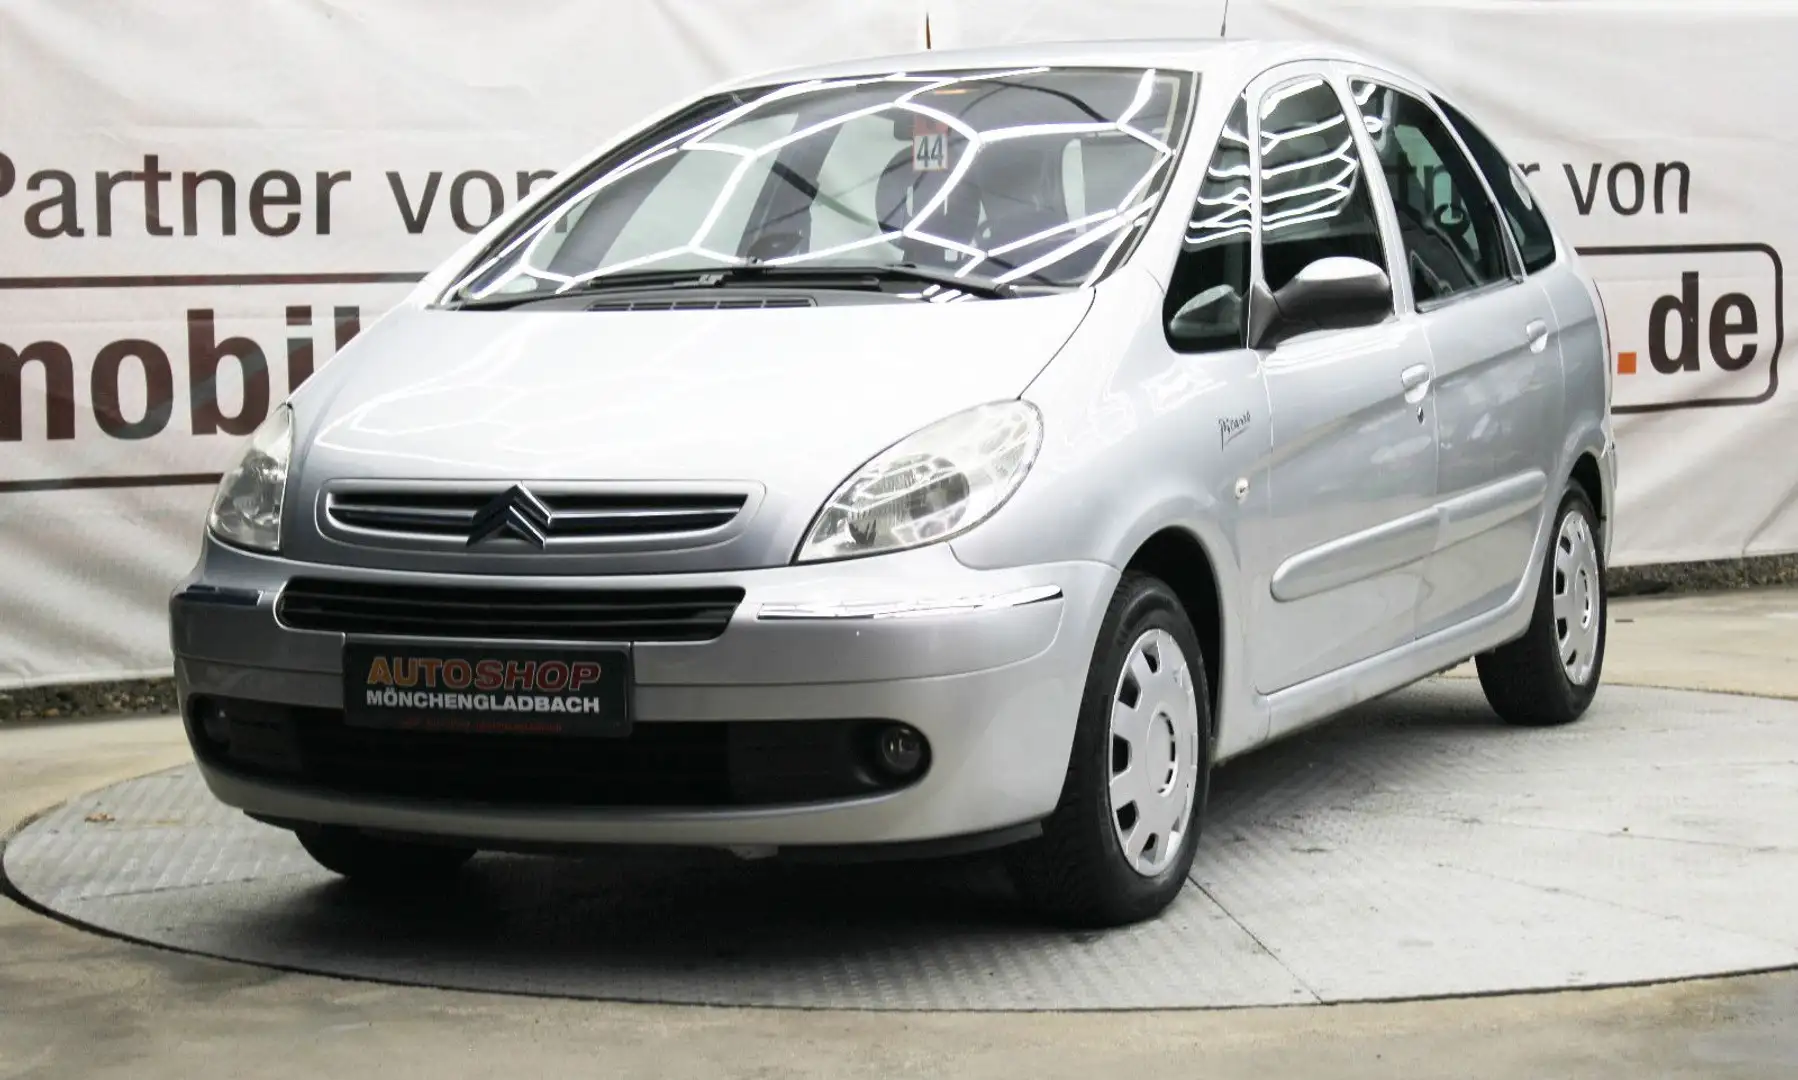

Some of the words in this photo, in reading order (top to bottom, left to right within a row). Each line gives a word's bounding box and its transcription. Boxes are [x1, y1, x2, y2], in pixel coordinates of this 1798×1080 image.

[916, 134, 944, 168] 44
[1562, 161, 1690, 216] von
[1617, 271, 1758, 375] .de
[366, 656, 601, 691] AUTOSHOP
[366, 688, 600, 713] MÖNCHENGLADBACH
